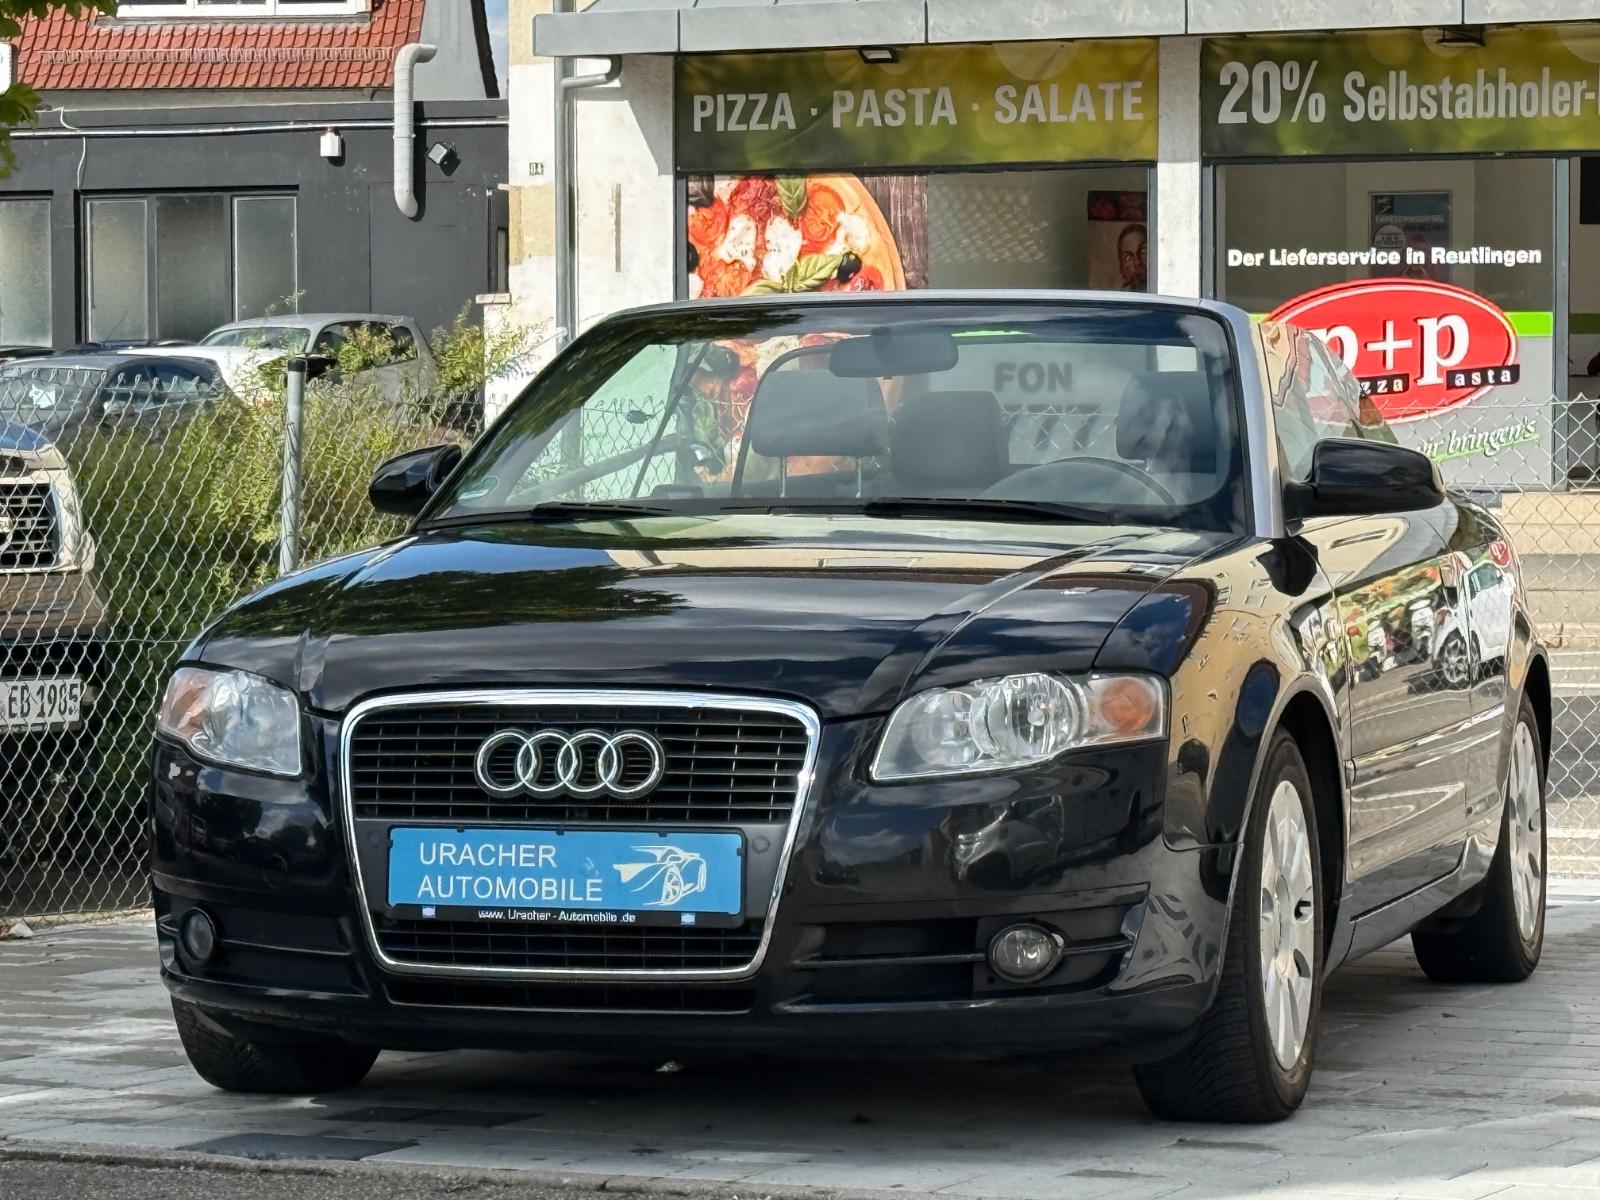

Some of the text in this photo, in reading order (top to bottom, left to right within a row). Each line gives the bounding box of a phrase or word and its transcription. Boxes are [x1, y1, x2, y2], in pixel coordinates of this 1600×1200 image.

[693, 93, 796, 132] PIZZA
[832, 87, 957, 128] PASTA
[994, 81, 1144, 124] SALATE
[1218, 60, 1600, 124] 20% Selbstabholer-
[1228, 249, 1264, 266] Der
[1269, 247, 1400, 266] Lieferservice
[1431, 246, 1542, 265] Reutlingen
[993, 362, 1073, 393] FON
[1454, 369, 1512, 388] asta
[8, 683, 79, 718] EB 1985
[419, 843, 557, 868] URACHER
[417, 875, 603, 902] AUTOMOBILE
